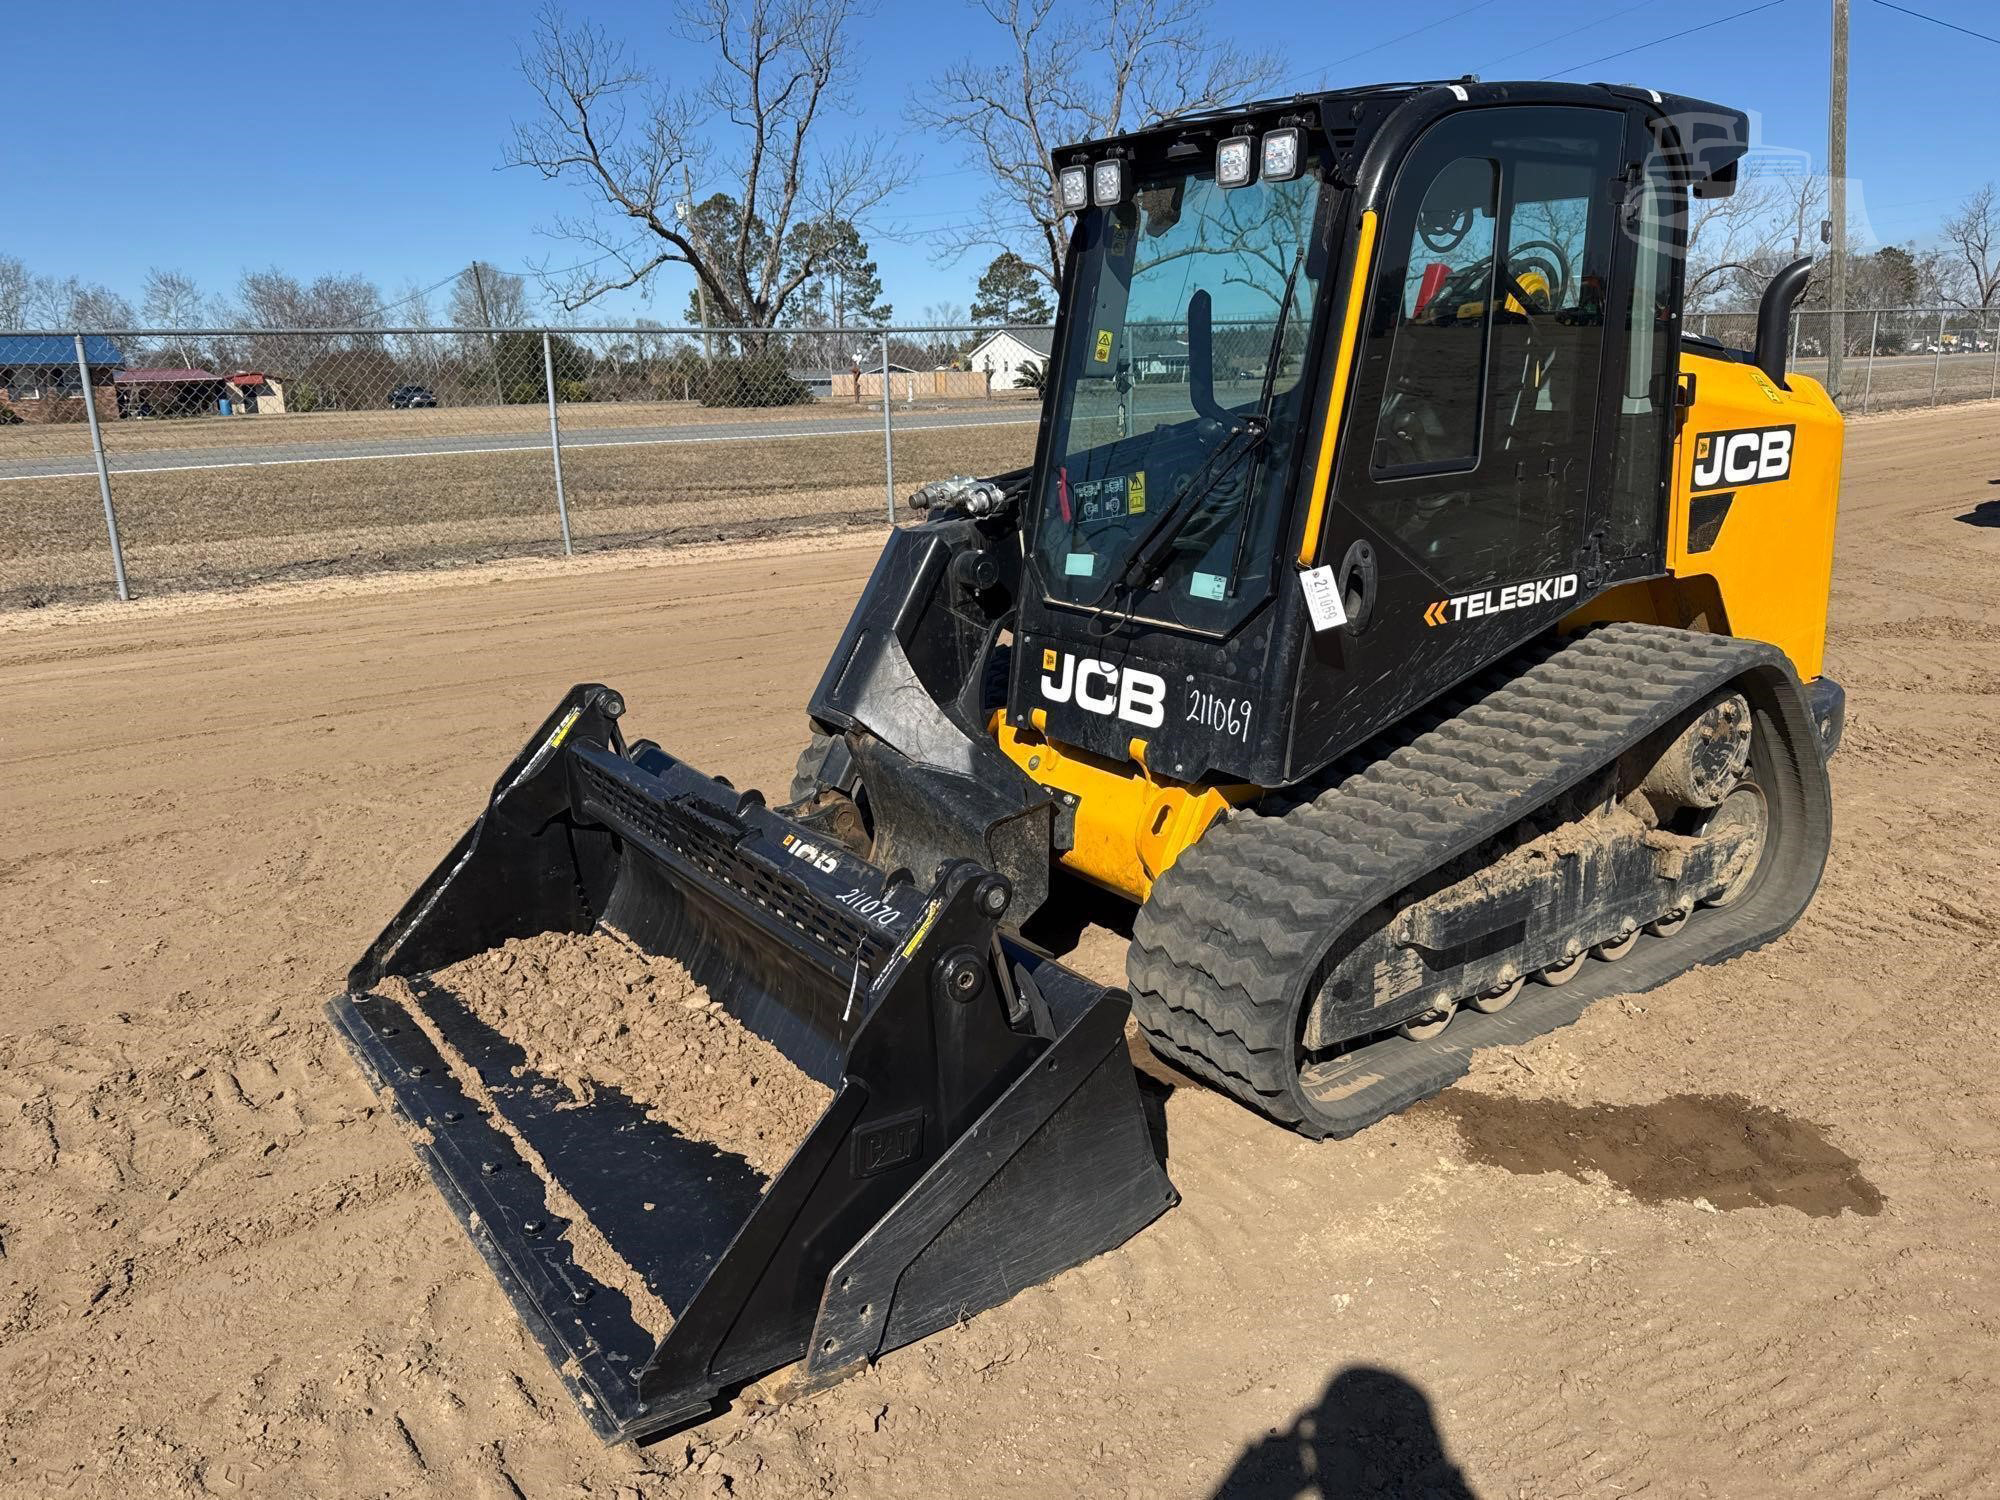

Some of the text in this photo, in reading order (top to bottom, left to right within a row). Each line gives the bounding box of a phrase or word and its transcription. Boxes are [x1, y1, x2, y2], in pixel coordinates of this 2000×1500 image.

[1694, 430, 1792, 487] JCB
[1313, 579, 1338, 620] 211069
[1450, 574, 1578, 621] TELESKID
[1041, 653, 1167, 729] JCB
[1186, 689, 1252, 743] 211069
[835, 888, 901, 926] 211070
